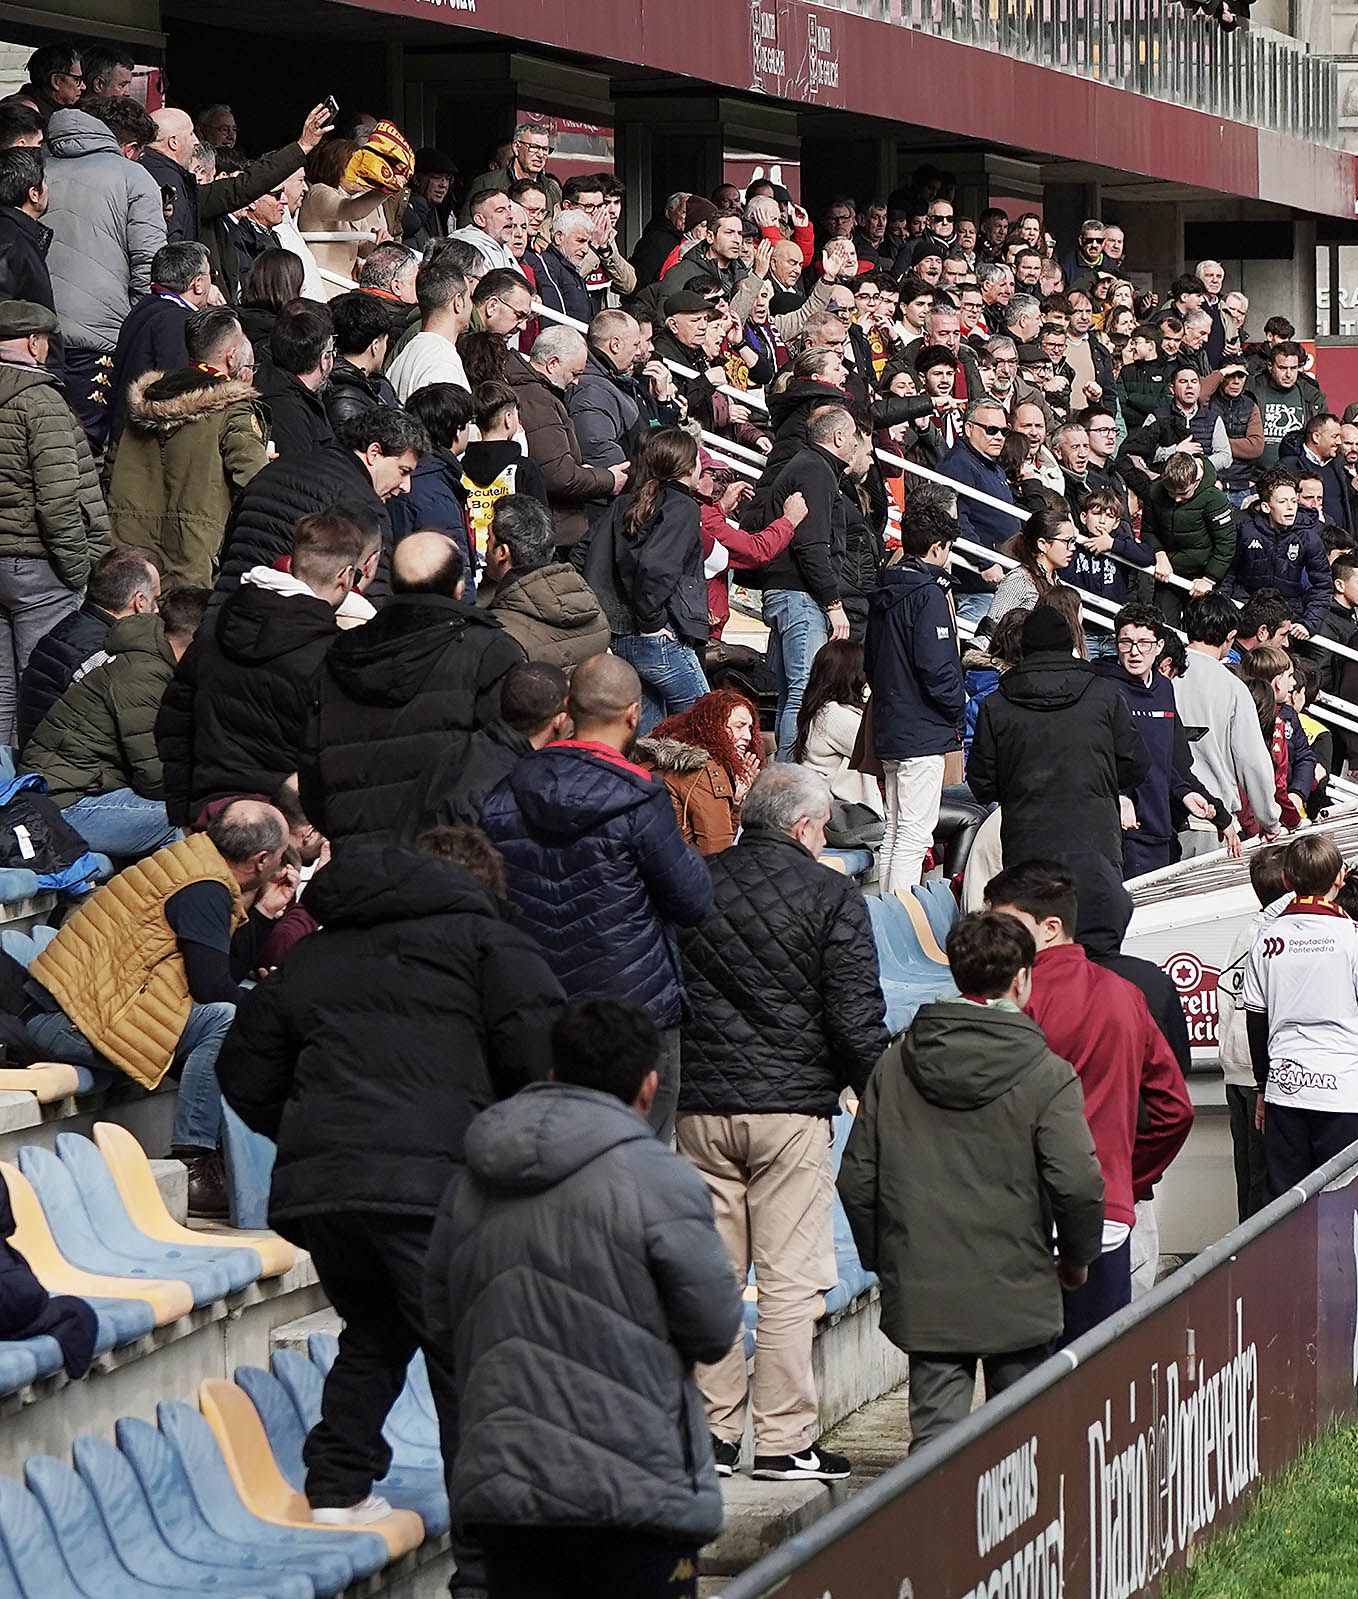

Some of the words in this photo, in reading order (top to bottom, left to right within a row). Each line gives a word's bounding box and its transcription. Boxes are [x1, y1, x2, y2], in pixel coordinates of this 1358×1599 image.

[1288, 936, 1335, 947] Deputación
[976, 1435, 1038, 1558] CONSERVAS
[1088, 1375, 1148, 1599] Diario
[1166, 1297, 1260, 1558] Pontevedra
